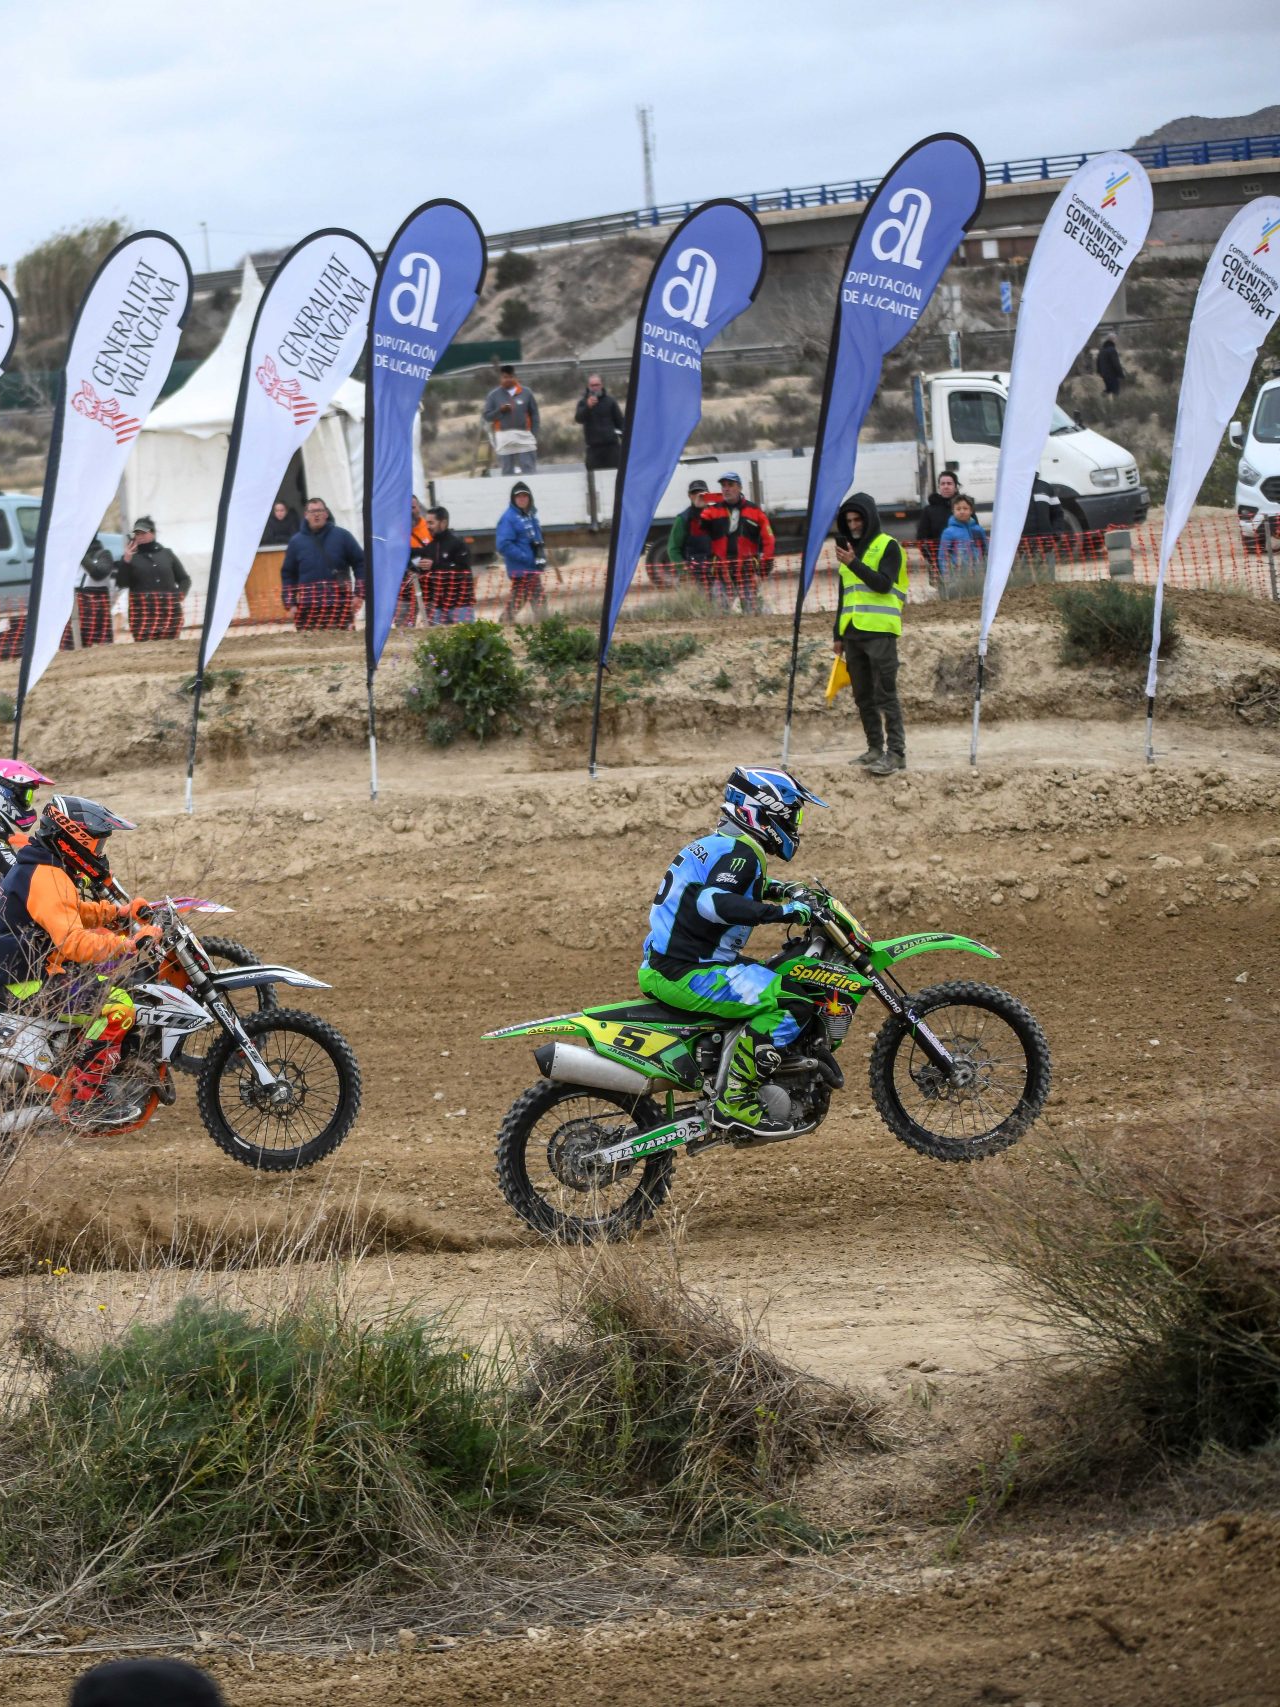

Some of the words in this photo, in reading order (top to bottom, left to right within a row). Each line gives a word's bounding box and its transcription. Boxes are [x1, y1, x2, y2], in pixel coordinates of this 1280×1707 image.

[1065, 204, 1123, 258] COMUNITAT
[1072, 193, 1101, 220] Comunitat
[1099, 215, 1128, 246] Valenciana
[1064, 220, 1078, 239] DE
[1078, 234, 1124, 277] L'ESPORT
[846, 271, 922, 300] DIPUTACIÓN
[278, 252, 351, 367] GENERALITAT
[843, 289, 859, 304] DE
[862, 294, 920, 320] ALICANTE
[92, 257, 158, 386] GENERALITAT
[114, 276, 180, 397] VALENCIANA
[298, 276, 371, 382] VALENCIANA
[375, 333, 437, 362] DIPUTACIÓN
[643, 322, 702, 355] DIPUTACIÓ
[375, 354, 389, 370] DE
[642, 342, 656, 357] DE
[656, 344, 702, 372] ALICANT
[754, 790, 793, 819] 100%
[902, 934, 945, 951] NAVARRO
[789, 964, 862, 993] SplitFire
[868, 974, 902, 1014] JFRacing
[527, 1025, 576, 1035] ACERBIS
[613, 1026, 652, 1052] 5
[608, 1127, 688, 1162] NAVARRO
